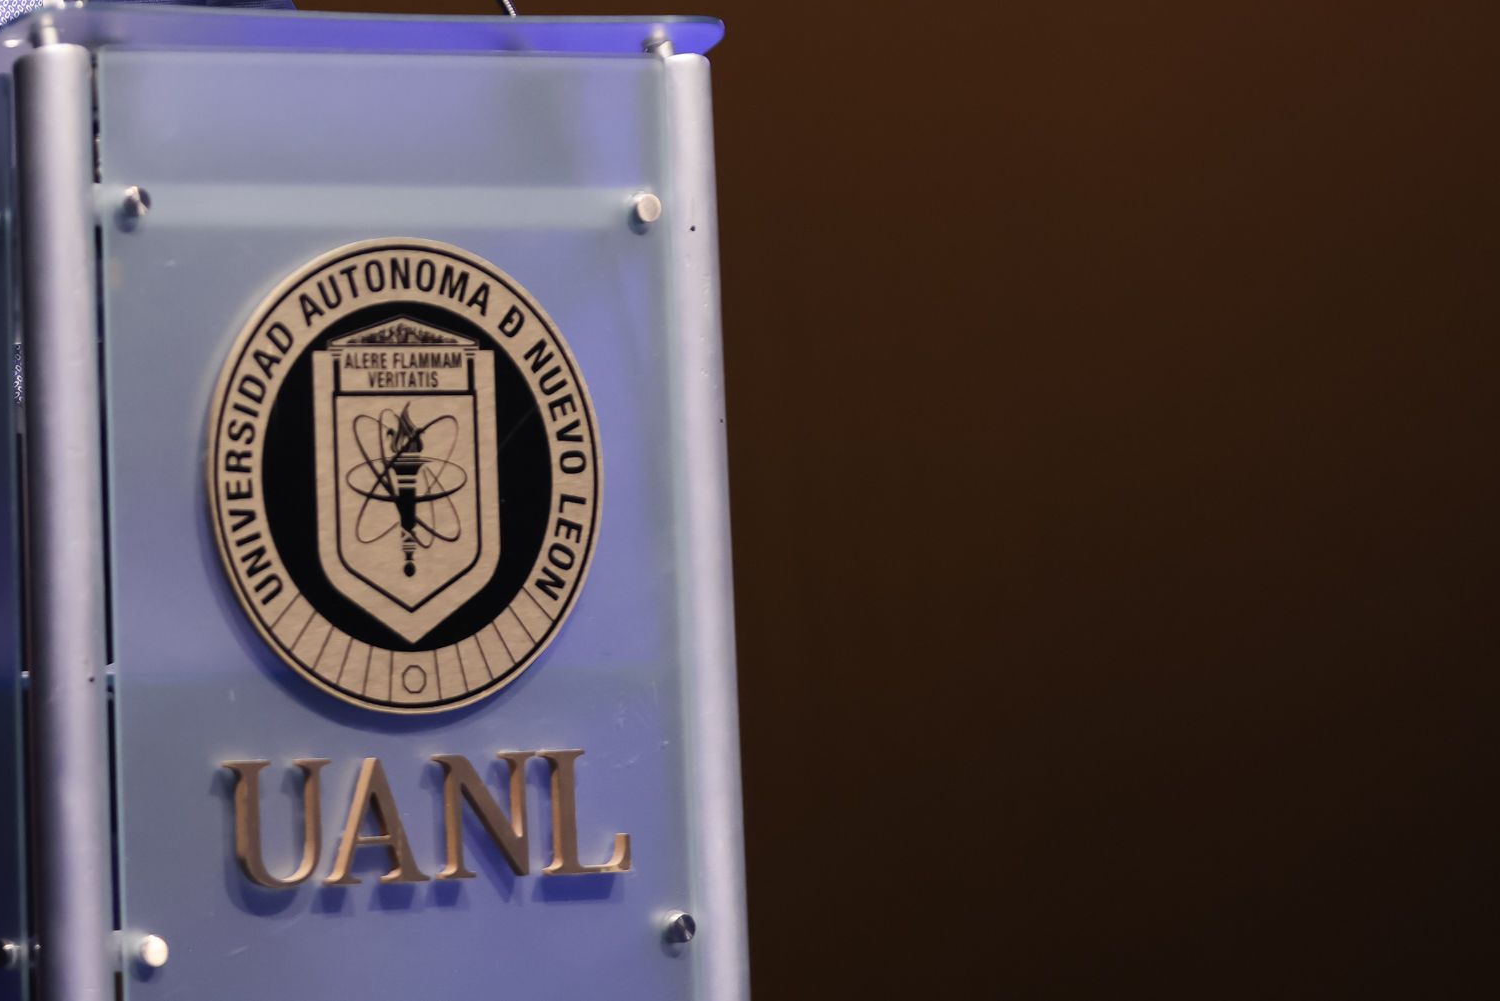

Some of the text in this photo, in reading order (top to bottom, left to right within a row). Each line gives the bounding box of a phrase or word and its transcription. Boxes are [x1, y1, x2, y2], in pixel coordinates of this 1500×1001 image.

[299, 256, 491, 327] AUTONOMA
[344, 352, 463, 370] ALERE FLAMMAM
[367, 370, 440, 389] VERITATIS
[523, 338, 587, 475] NUEVO
[224, 321, 294, 606] UNIVERSIDAD
[535, 494, 588, 602] LEON
[221, 748, 632, 889] UANL
